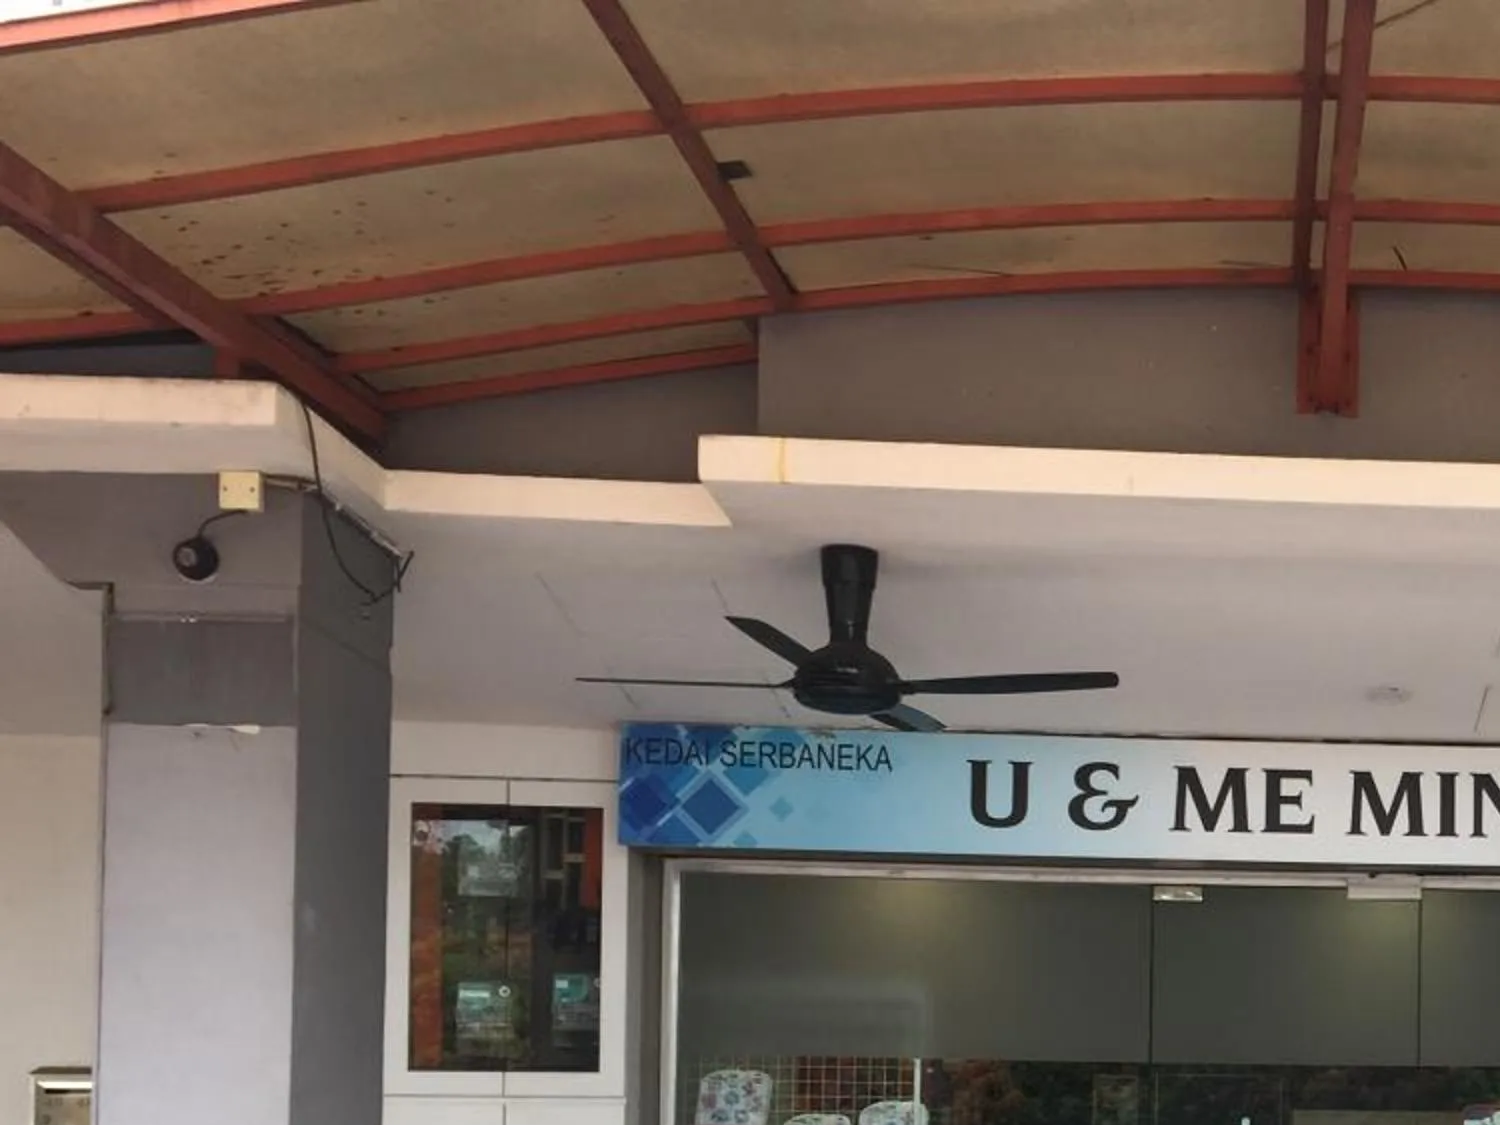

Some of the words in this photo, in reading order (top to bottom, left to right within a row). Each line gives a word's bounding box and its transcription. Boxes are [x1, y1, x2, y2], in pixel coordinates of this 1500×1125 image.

[625, 737, 709, 766] KEDAI
[719, 740, 894, 773] SERBANEKA
[966, 759, 1033, 829] U
[1067, 761, 1139, 831] &
[1169, 765, 1315, 834] ME
